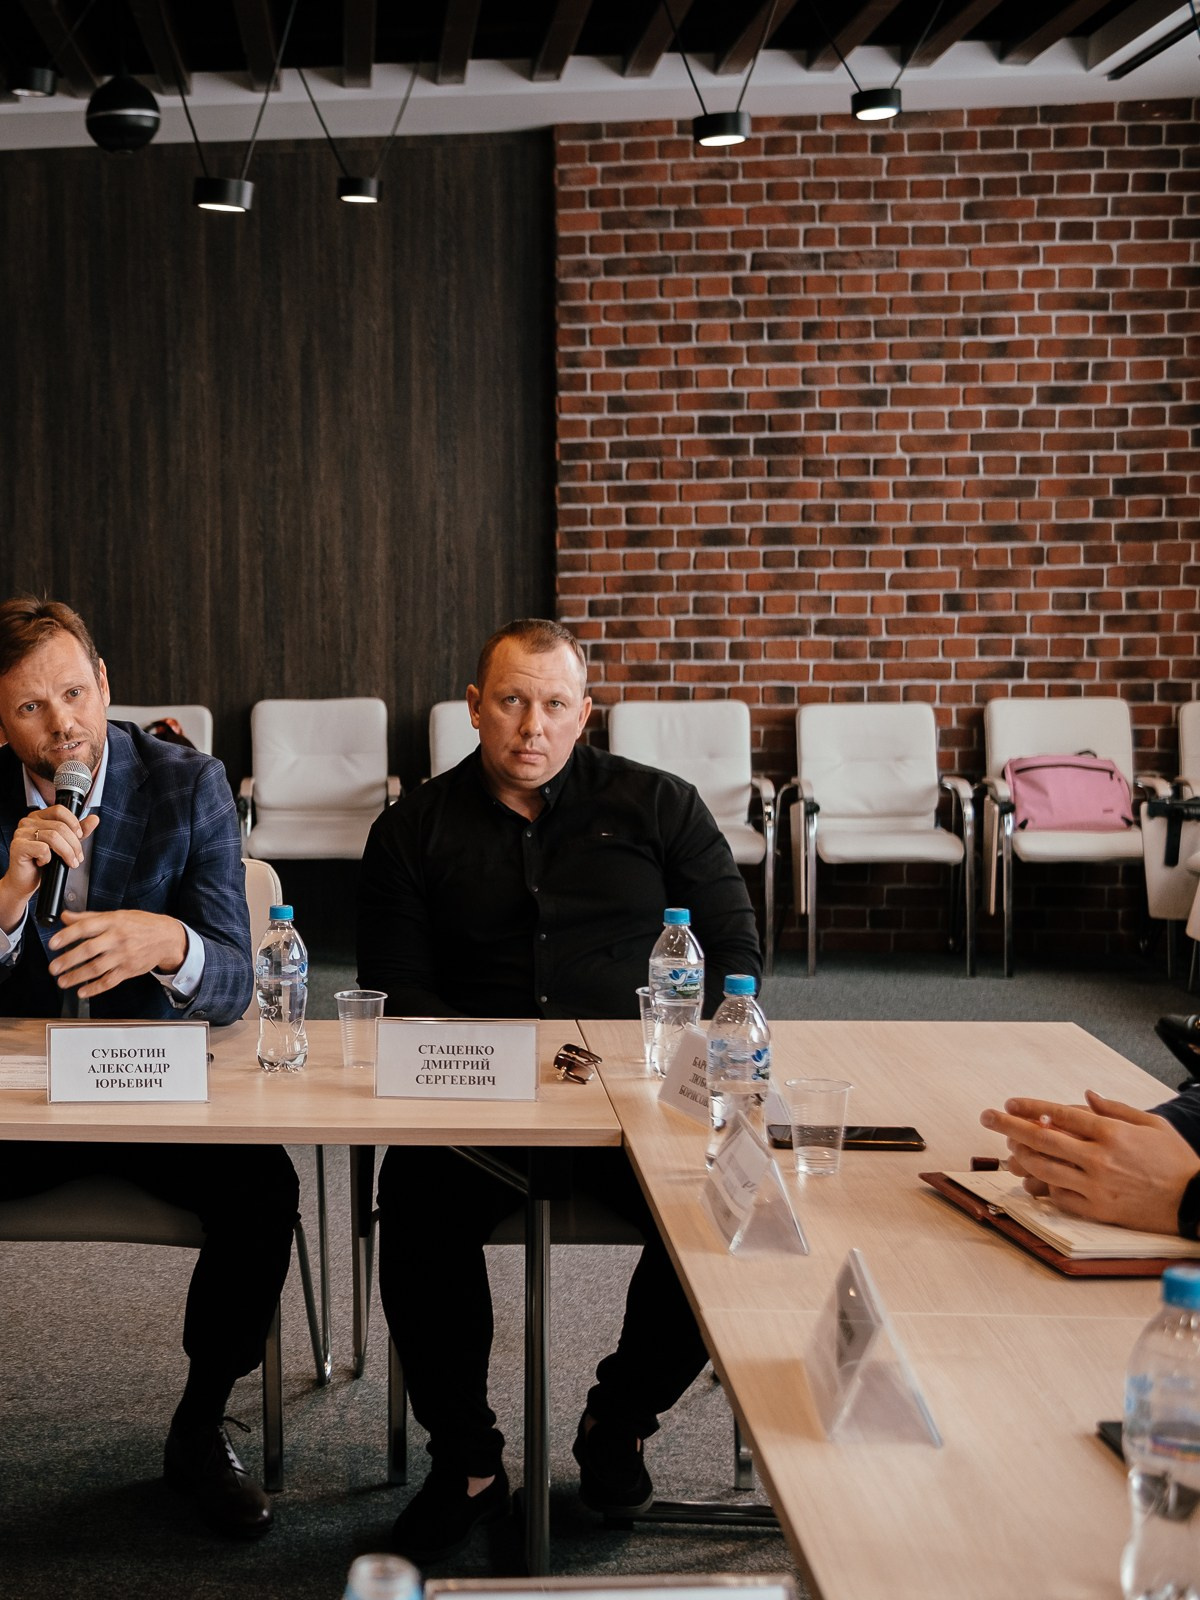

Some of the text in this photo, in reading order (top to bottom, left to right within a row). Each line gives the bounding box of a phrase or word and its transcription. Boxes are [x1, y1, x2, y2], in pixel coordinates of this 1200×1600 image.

[91, 1048, 166, 1059] СУББОТИН
[418, 1044, 495, 1056] СТАЦЕНКО
[87, 1063, 170, 1075] АЛЕКСАНДР
[421, 1058, 491, 1071] ДМИТРИЙ
[692, 1056, 707, 1072] БАР
[95, 1078, 163, 1089] ЮРЬЕВИЧ
[415, 1074, 497, 1086] СЕРГЕЕВИЧ
[679, 1084, 709, 1109] БОРИСОВ
